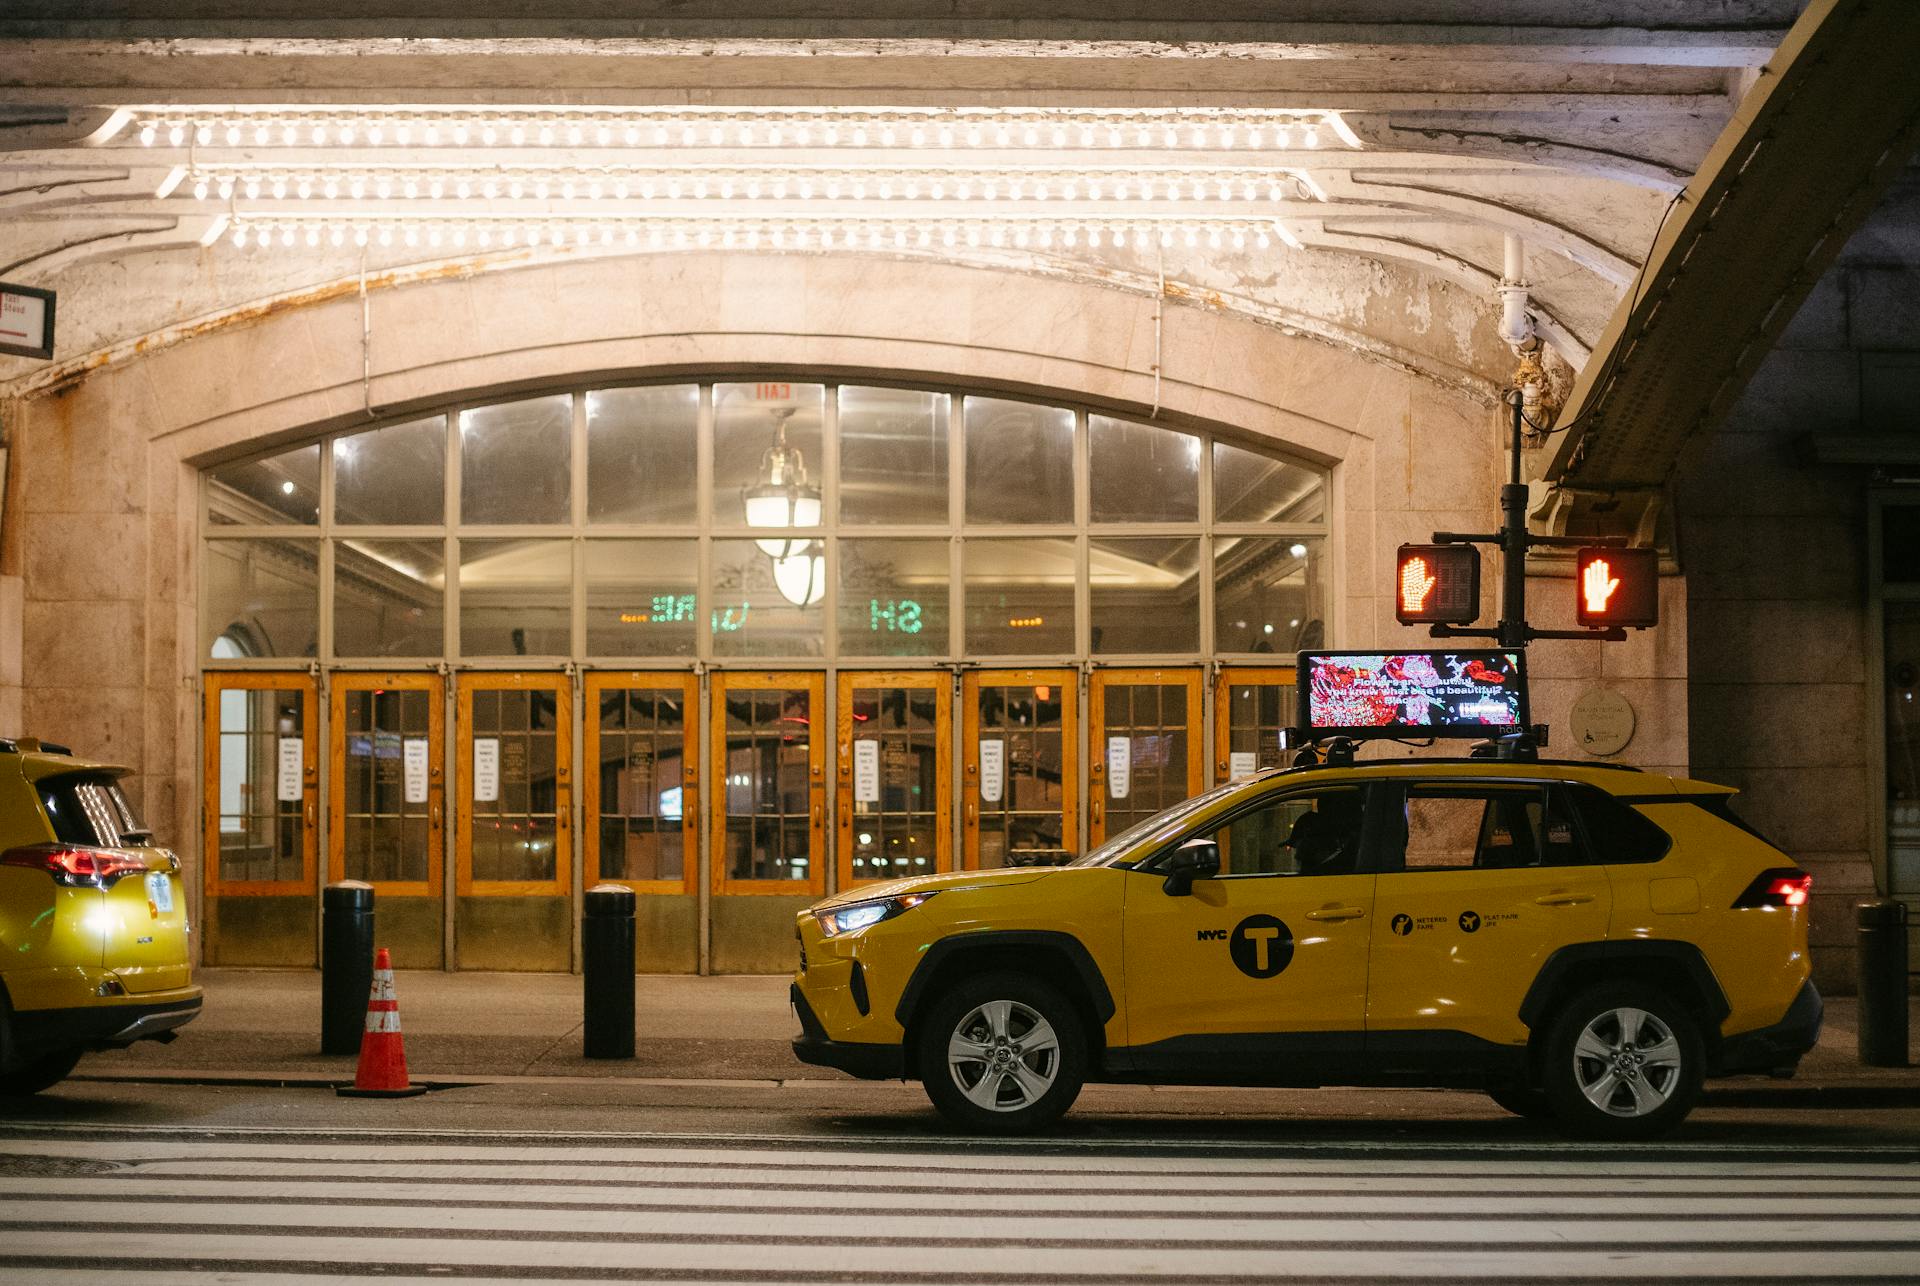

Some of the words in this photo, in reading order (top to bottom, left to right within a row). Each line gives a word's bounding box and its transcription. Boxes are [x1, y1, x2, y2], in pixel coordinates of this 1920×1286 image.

[1435, 686, 1445, 696] is
[1198, 929, 1227, 940] NYC
[1244, 927, 1278, 970] T
